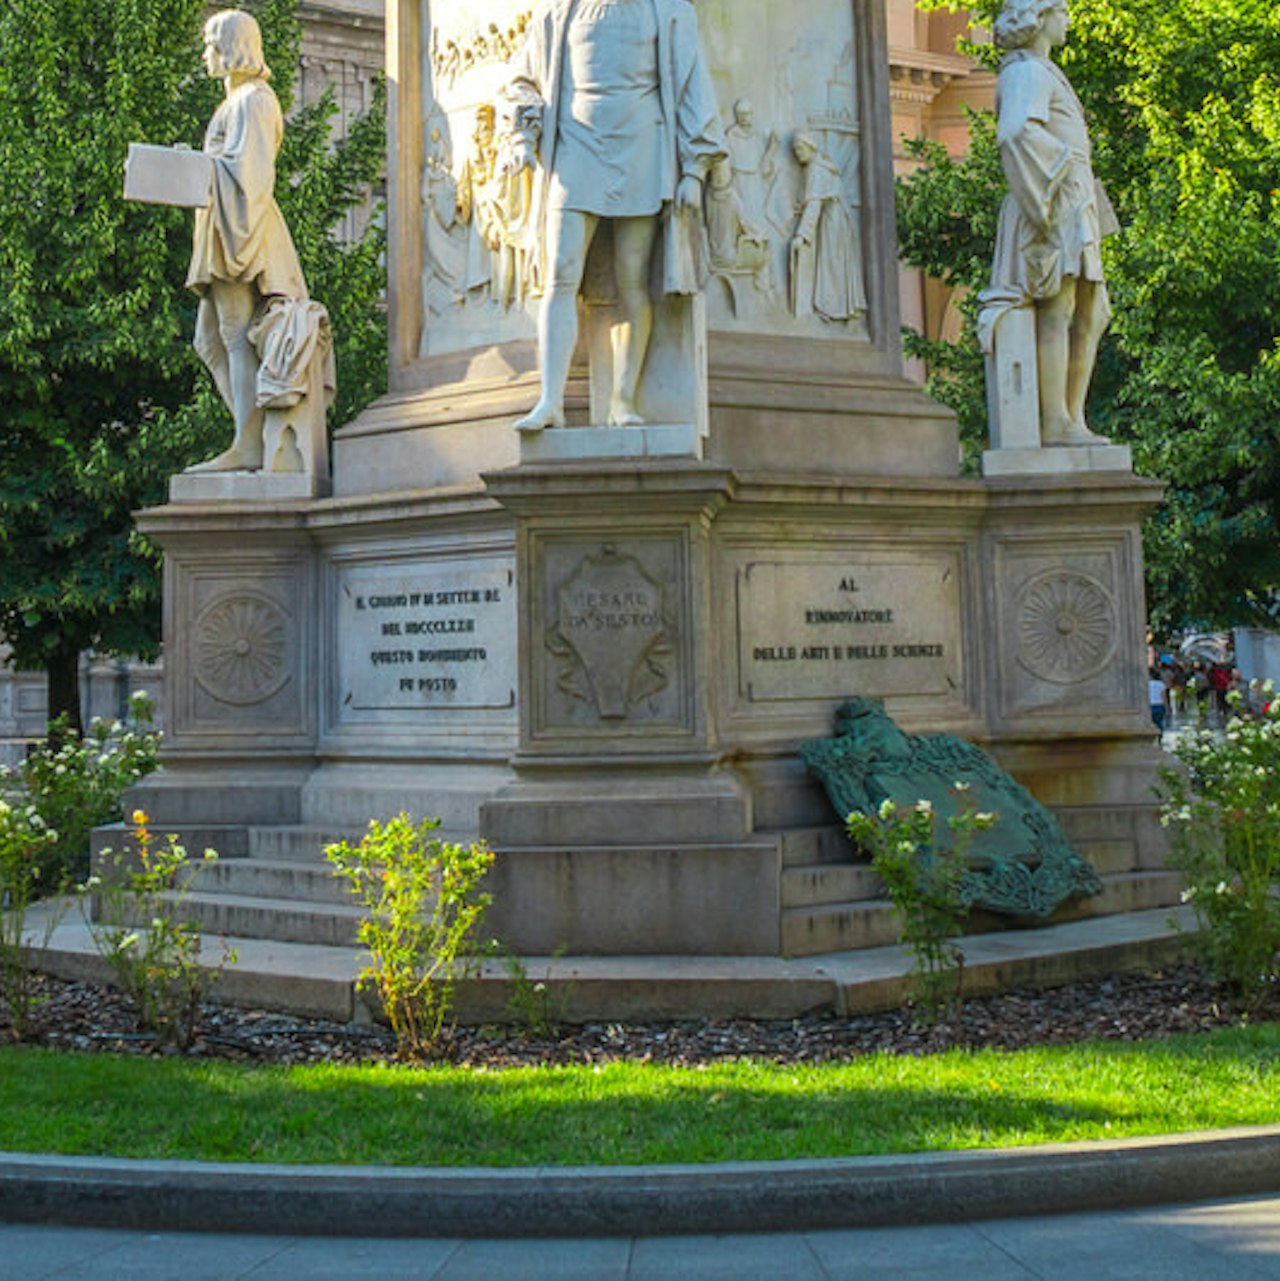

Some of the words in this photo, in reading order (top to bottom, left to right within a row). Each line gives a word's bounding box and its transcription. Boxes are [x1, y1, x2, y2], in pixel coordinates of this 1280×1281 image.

[838, 578, 859, 591] AL
[805, 609, 893, 623] RINNOVATORE
[753, 646, 797, 660] DELLE
[800, 646, 830, 659] ARTI
[834, 647, 843, 659] E
[847, 645, 888, 658] DELLE
[892, 644, 943, 657] SCIENZE
